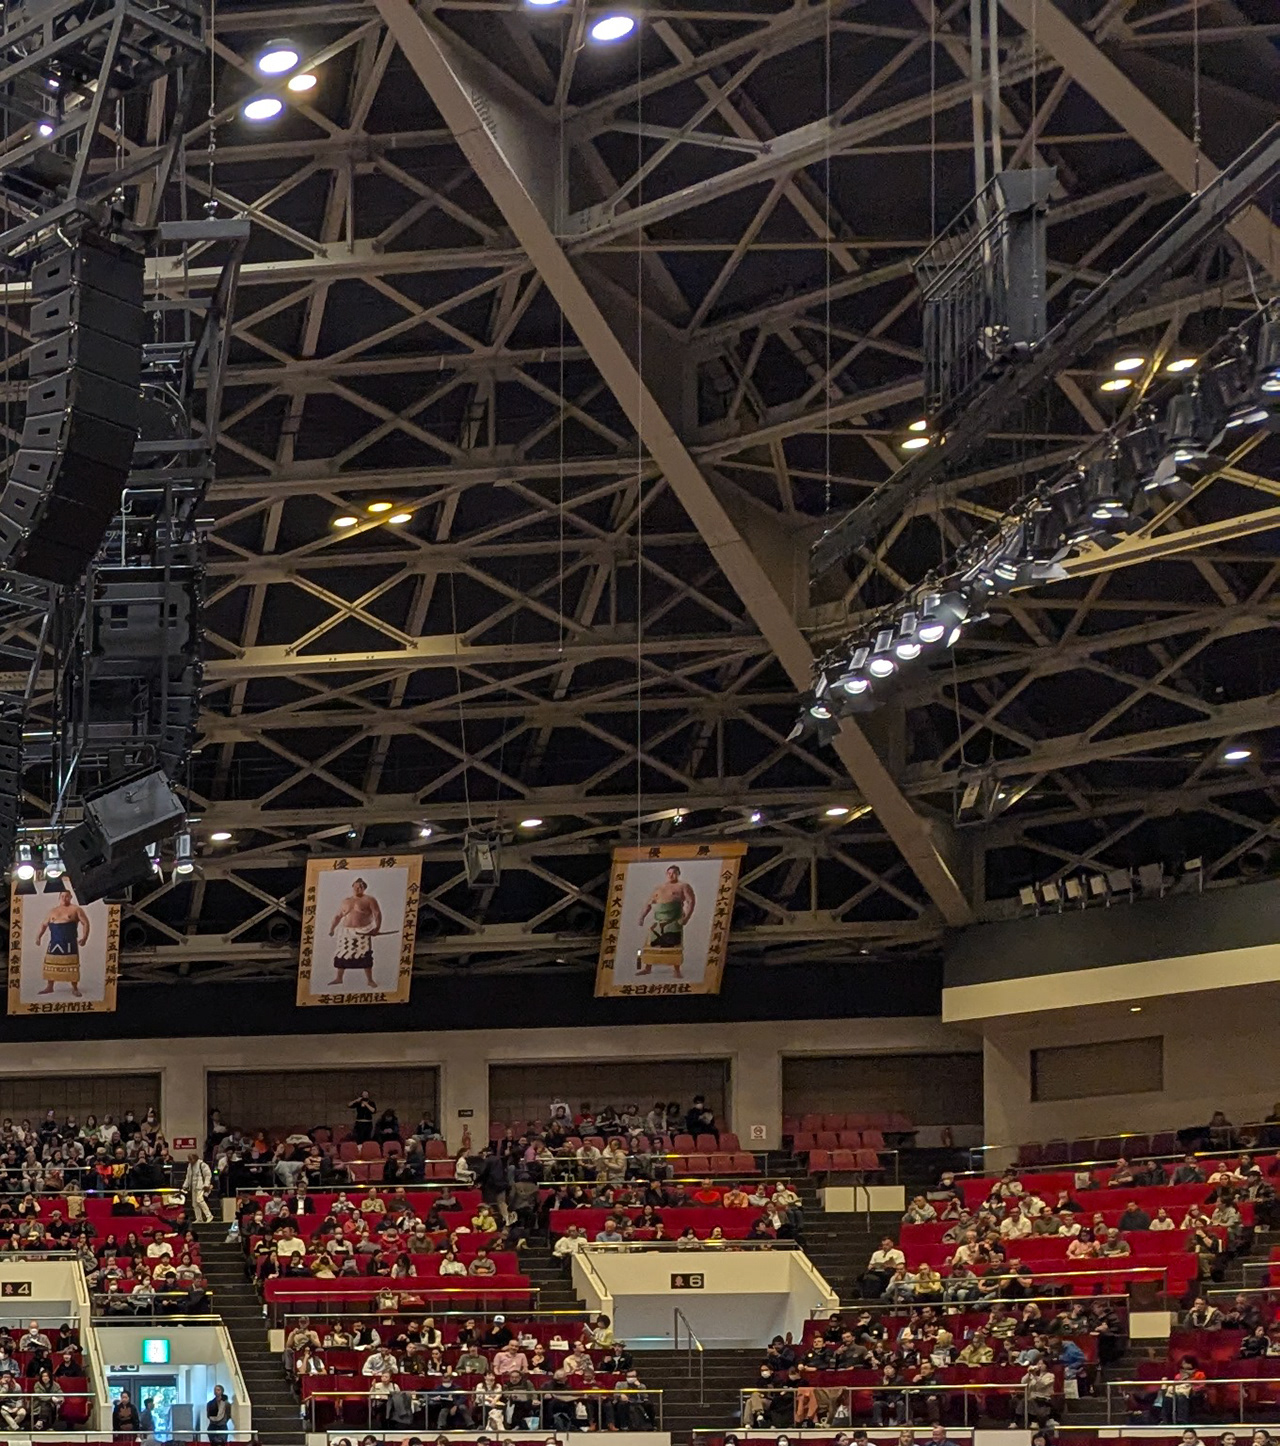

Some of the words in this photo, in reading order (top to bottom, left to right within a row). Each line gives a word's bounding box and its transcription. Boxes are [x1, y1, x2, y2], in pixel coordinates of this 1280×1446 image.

[648, 845, 711, 858] 優勝
[332, 858, 398, 871] 優勝
[706, 870, 734, 966] 令和六年九月場所
[398, 882, 420, 977] 令和六年七月場所
[619, 983, 693, 995] 毎日新聞社
[317, 993, 388, 1004] 毎日新聞社
[27, 1002, 95, 1013] 毎日新聞社
